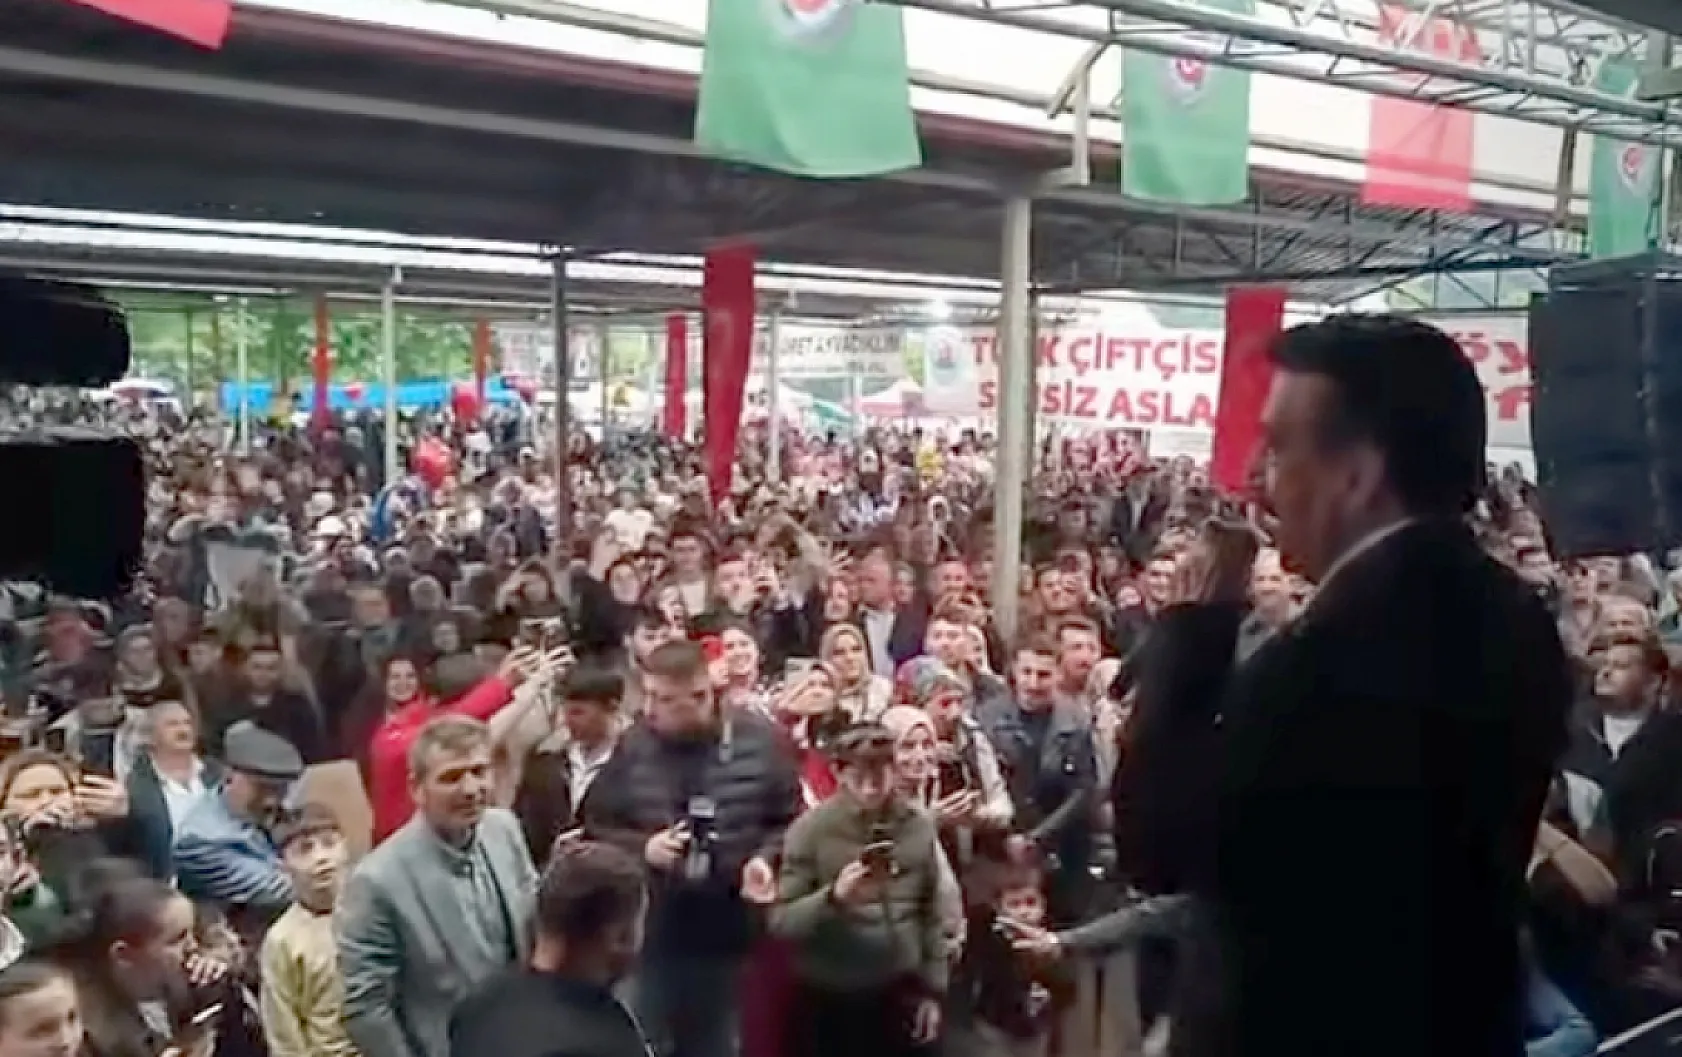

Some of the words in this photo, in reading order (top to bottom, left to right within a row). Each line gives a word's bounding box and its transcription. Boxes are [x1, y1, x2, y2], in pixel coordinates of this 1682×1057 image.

[972, 335, 1061, 367] TK
[1068, 332, 1218, 381] ÇİFTÇİS
[978, 379, 1098, 418] SSİZ
